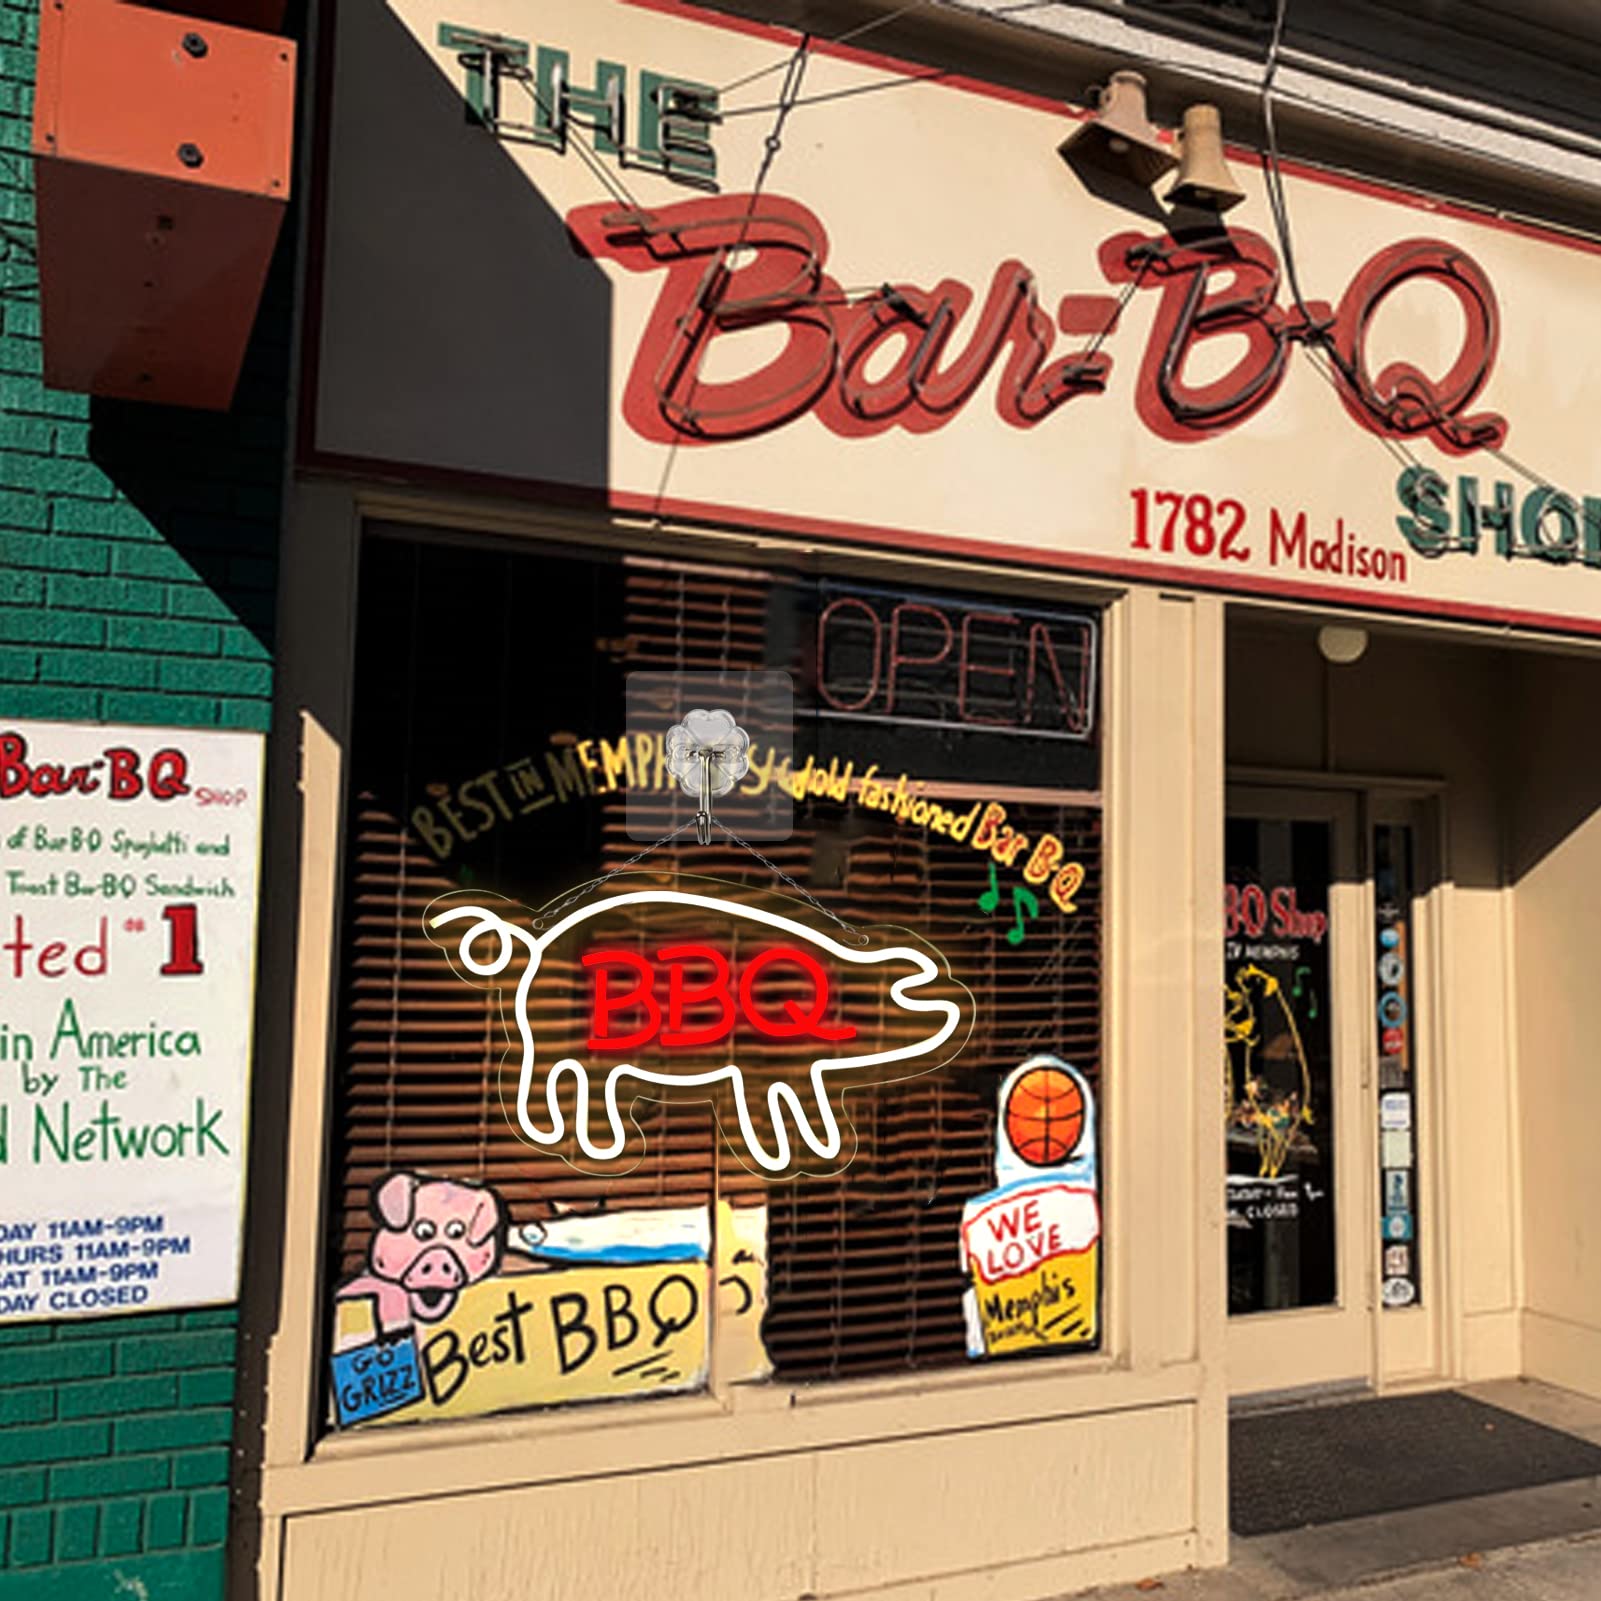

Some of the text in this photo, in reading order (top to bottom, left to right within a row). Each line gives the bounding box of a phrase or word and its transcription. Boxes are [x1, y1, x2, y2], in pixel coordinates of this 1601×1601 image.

[438, 22, 720, 190] THE
[1130, 487, 1408, 582] 1782 Madison
[817, 598, 1093, 733] OPEN
[411, 768, 513, 857] BEST
[546, 733, 676, 803] MEMPH
[857, 765, 982, 842] fashioned
[196, 834, 230, 856] and
[145, 873, 235, 897] Sandwich
[1270, 886, 1327, 944] Shop
[581, 944, 857, 1050] BBQ
[1, 997, 202, 1060] in America
[22, 1061, 128, 1096] by The
[33, 1097, 229, 1163] Network
[48, 1216, 164, 1239] 11AM-9PM
[987, 1200, 1042, 1241] WE
[0, 1262, 158, 1289] AT 11AM-9PM
[76, 1237, 190, 1262] 11AM-9PM
[987, 1224, 1061, 1276] LOVE
[50, 1285, 148, 1311] CLOSED
[984, 1269, 1076, 1328] Memphis
[352, 1349, 395, 1375] GO
[421, 1274, 699, 1407] Best BBQ
[343, 1365, 416, 1412] GRIZZ
